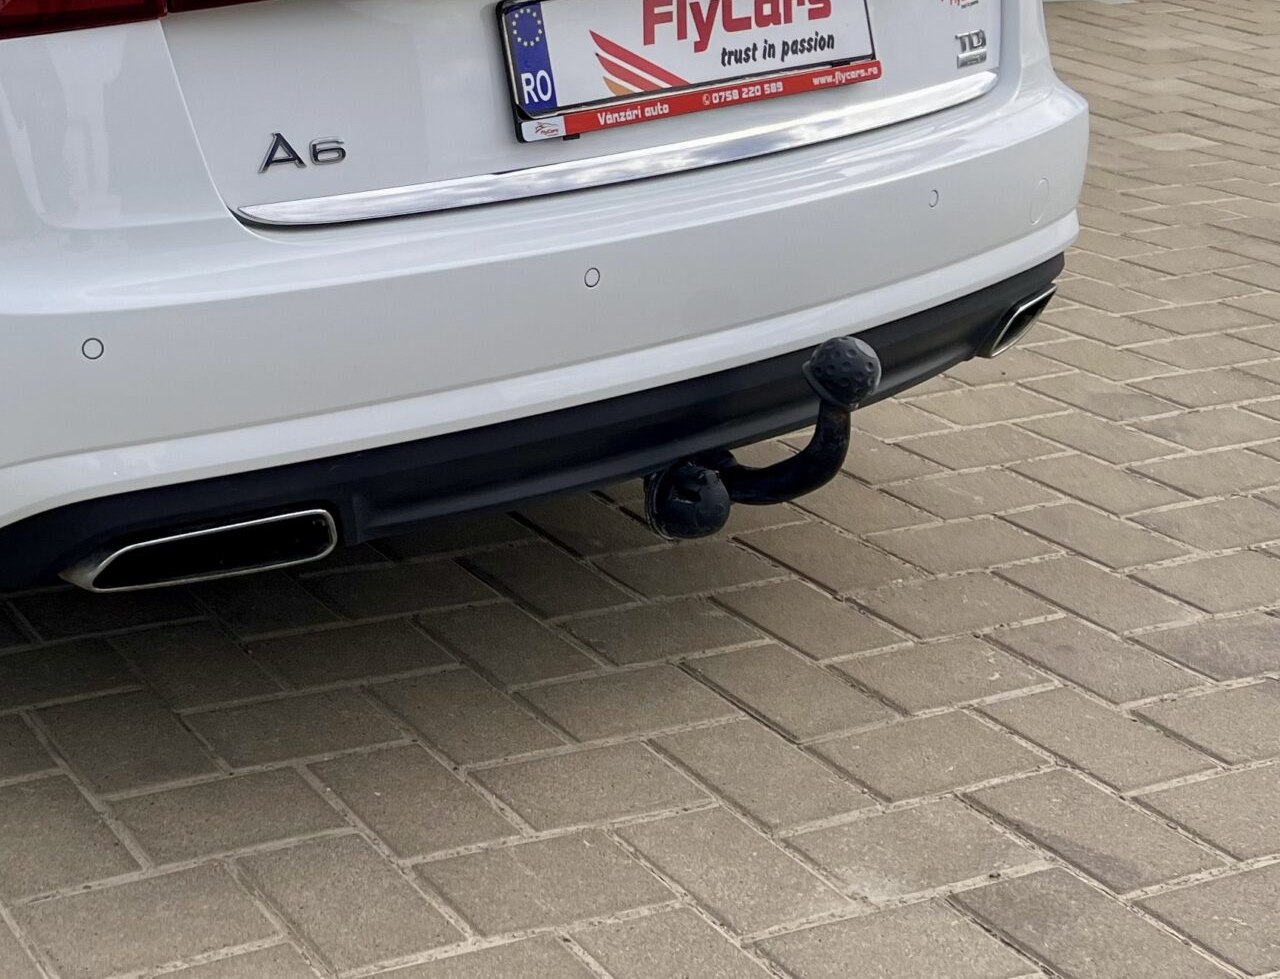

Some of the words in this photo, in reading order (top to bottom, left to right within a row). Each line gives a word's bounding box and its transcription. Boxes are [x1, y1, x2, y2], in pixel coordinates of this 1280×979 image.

[721, 42, 758, 67] trust
[762, 39, 776, 60] in
[781, 31, 835, 62] passion
[520, 70, 552, 104] RO
[812, 67, 878, 86] www.flycars.ro
[712, 89, 740, 104] 0758
[742, 85, 762, 99] 220
[645, 102, 669, 118] auto
[258, 132, 347, 174] A6
